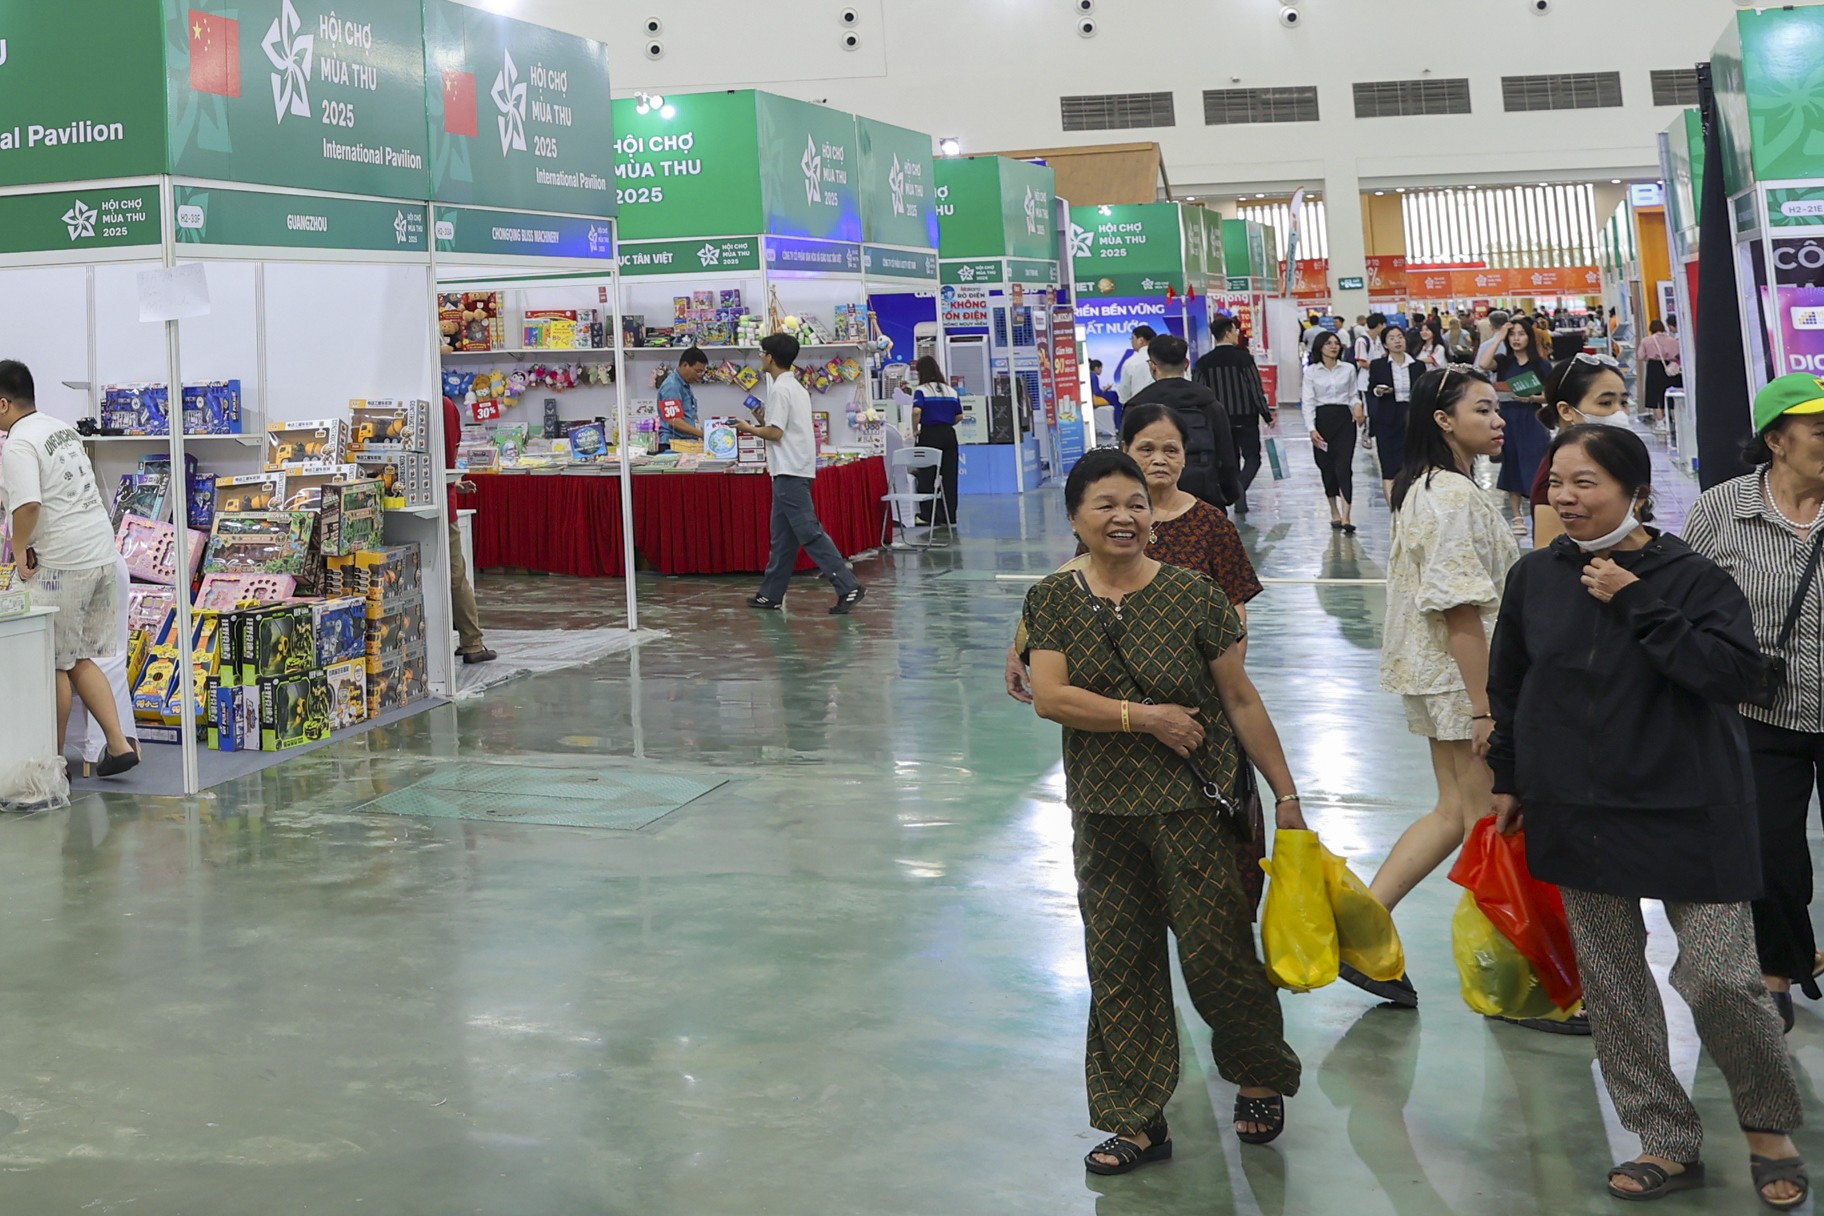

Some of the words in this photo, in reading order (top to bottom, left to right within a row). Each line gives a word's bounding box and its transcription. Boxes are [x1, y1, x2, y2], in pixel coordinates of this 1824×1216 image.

[319, 10, 342, 49] HỘI
[344, 21, 372, 56] CHỢ
[320, 51, 349, 85] MÙA
[351, 63, 377, 91] THU
[530, 61, 546, 93] HỘI
[548, 70, 567, 99] CHỢ
[321, 99, 355, 128] 2025
[531, 95, 553, 124] MÙA
[554, 104, 572, 127] THU
[28, 120, 124, 148] Pavilion
[533, 135, 558, 159] 2025
[649, 132, 694, 155] CHỢ
[323, 137, 384, 165] International
[385, 146, 422, 169] Pavilion
[660, 159, 702, 176] THU
[535, 166, 579, 188] International
[579, 172, 607, 191] Pavilion
[616, 187, 663, 204] 2025
[101, 198, 119, 212] HỘI
[121, 197, 142, 210] CHỢ
[1788, 205, 1823, 214] H2-21E
[102, 210, 124, 224] MÙA
[126, 212, 146, 222] THU
[180, 213, 201, 224] H2-33F
[286, 214, 328, 232] GUANGZHOU
[103, 227, 128, 237] 2025
[491, 226, 520, 242] CHONGQING
[534, 230, 560, 244] MACHINERY
[1098, 222, 1117, 235] HỘI
[1119, 222, 1142, 233] CHỢ
[1099, 234, 1122, 244] MÙA
[1125, 235, 1146, 244] THU
[618, 254, 630, 267] ỤC
[632, 252, 651, 264] TÂN
[652, 250, 673, 264] VIỆT
[1100, 249, 1127, 257] 2025
[1076, 282, 1095, 292] IET
[951, 299, 987, 309] KHÔNG
[1074, 304, 1099, 316] RIỂN
[1101, 303, 1127, 316] BỀN
[1127, 302, 1165, 315] VỮNG
[942, 310, 960, 320] ỐN
[963, 310, 988, 321] ĐIỆN
[1086, 320, 1104, 334] ẤT
[478, 408, 496, 419] 30%
[664, 405, 680, 417] 30%
